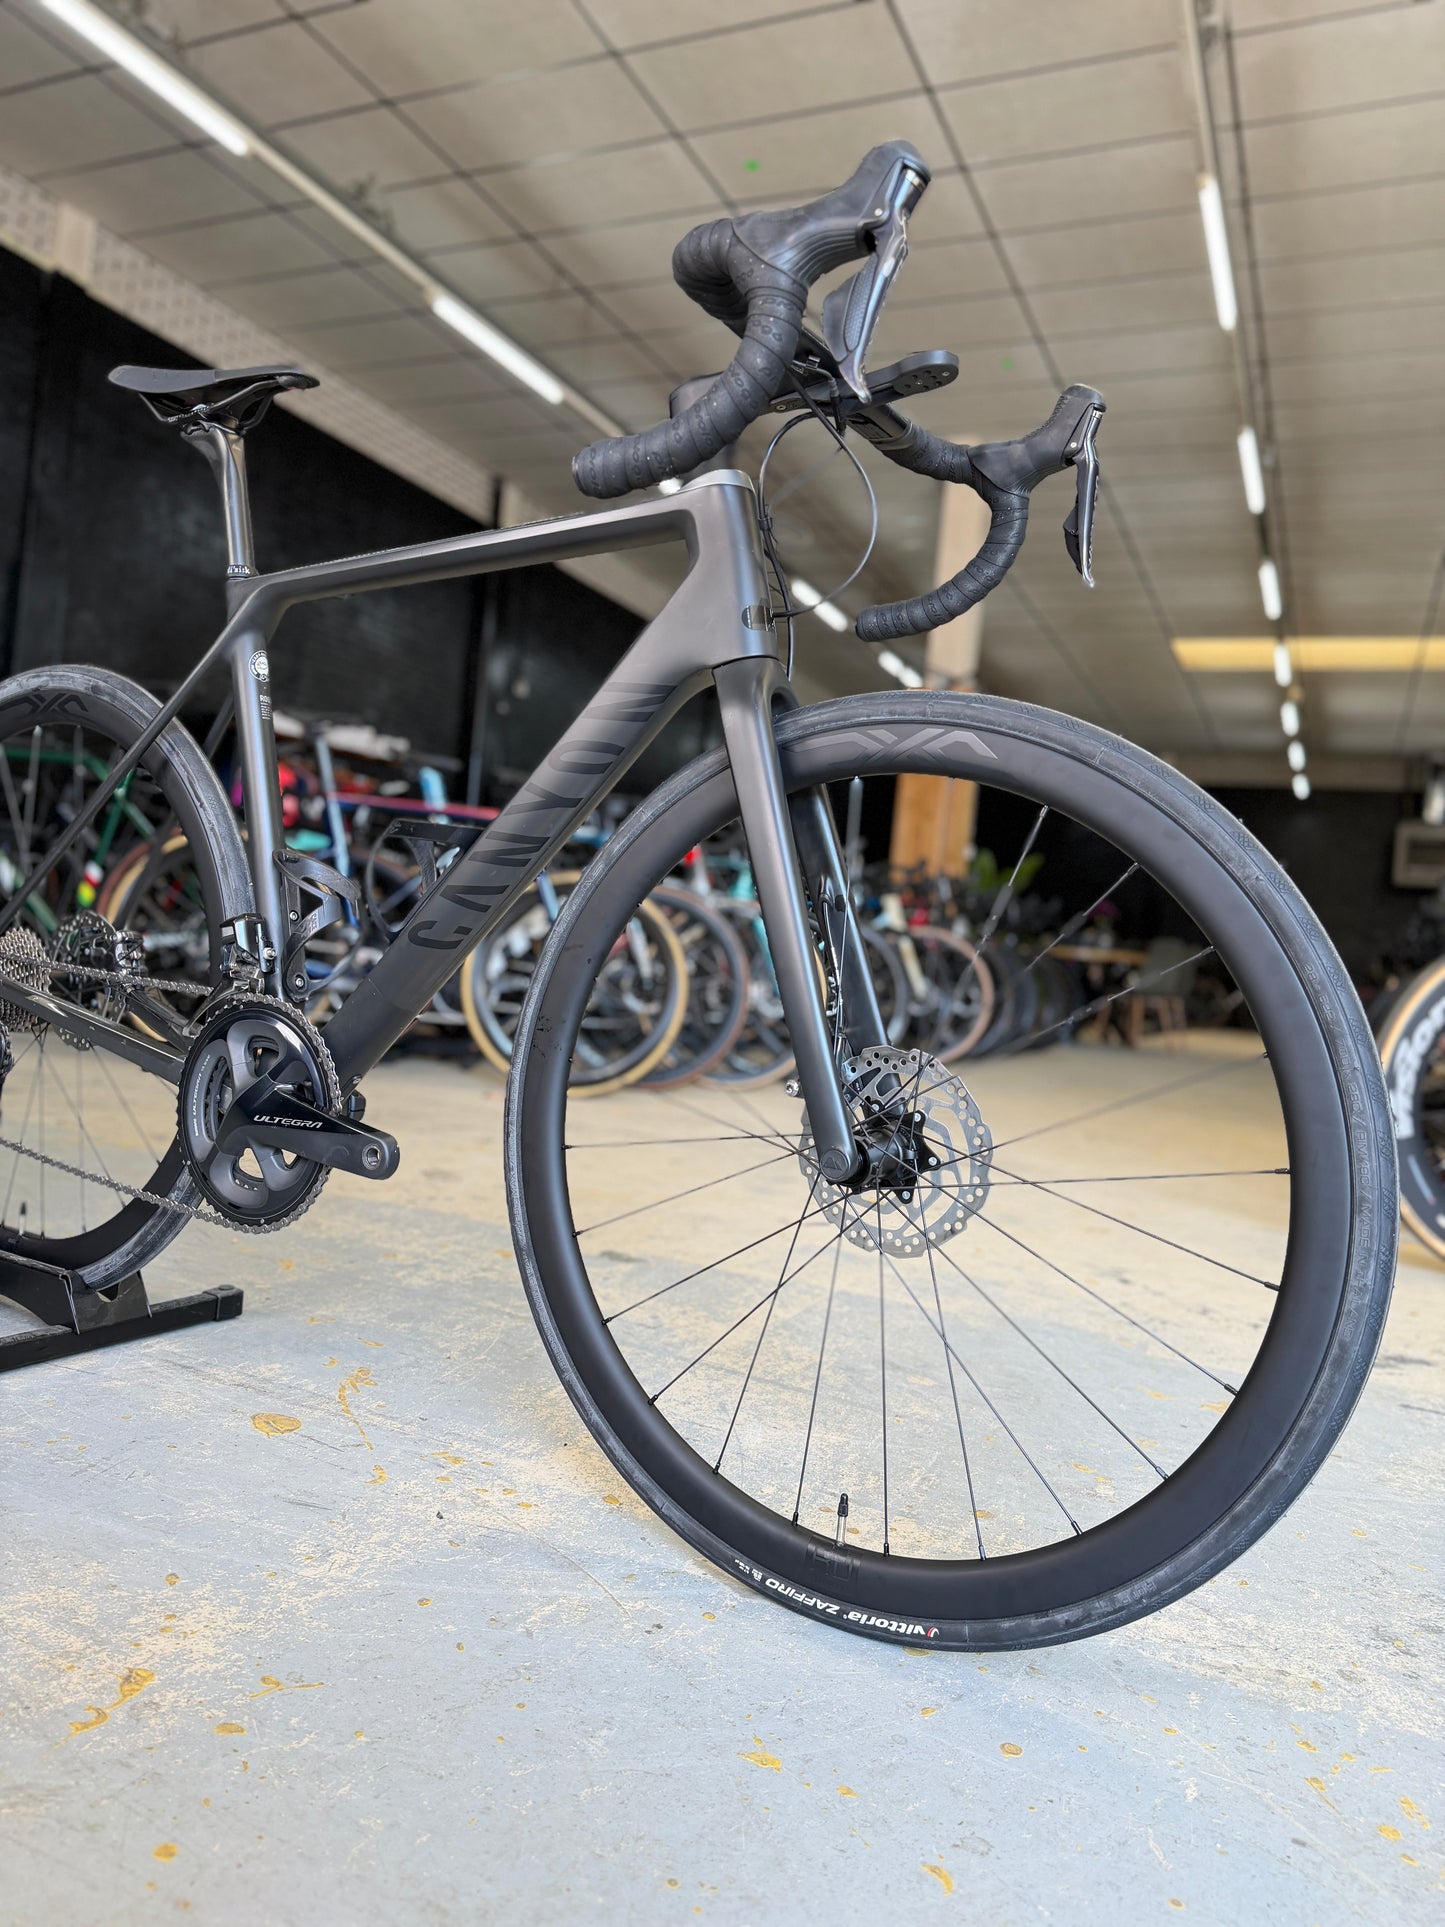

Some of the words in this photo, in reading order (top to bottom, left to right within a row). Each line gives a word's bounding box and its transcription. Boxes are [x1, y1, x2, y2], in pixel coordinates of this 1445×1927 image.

[409, 685, 676, 950] CANYON
[253, 1113, 324, 1130] ULTEGRA
[1359, 1204, 1370, 1246] MADE
[765, 1578, 839, 1616] ZAFFIRO
